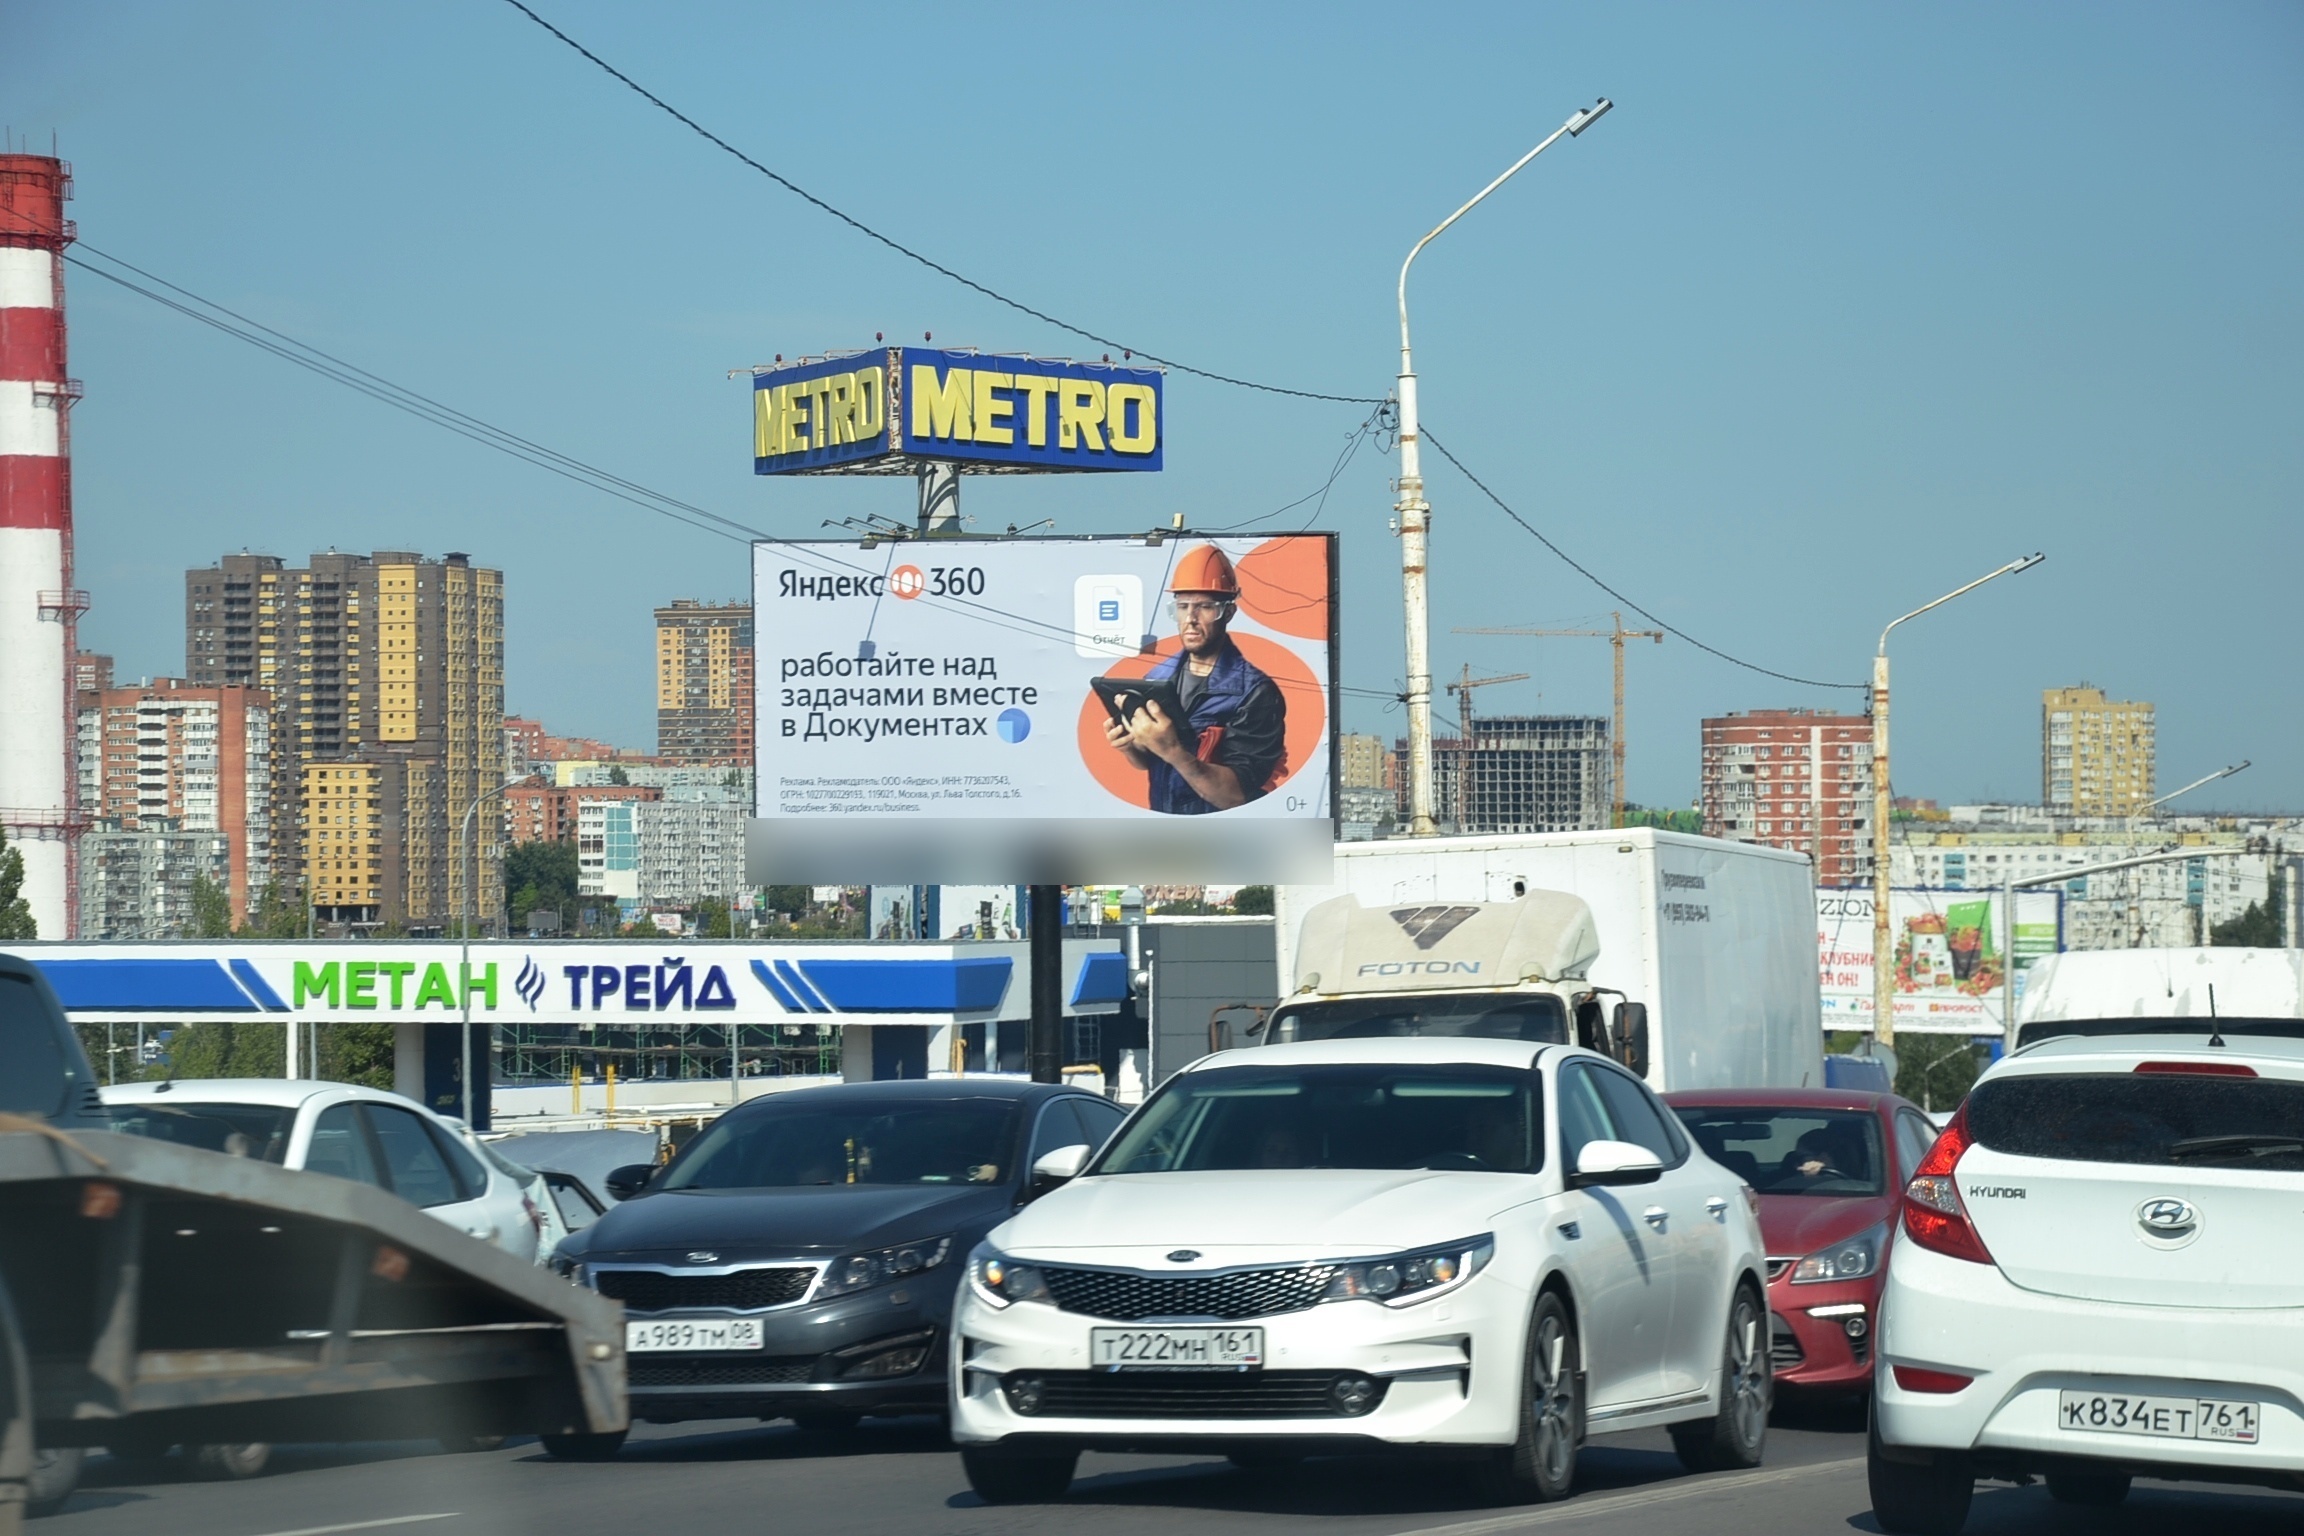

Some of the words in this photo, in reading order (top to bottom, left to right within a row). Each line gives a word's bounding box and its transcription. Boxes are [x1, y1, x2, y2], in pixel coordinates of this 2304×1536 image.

[755, 366, 883, 457] METRO
[912, 365, 1156, 453] METRO
[779, 569, 884, 601] Яндекс
[930, 567, 985, 596] 360
[1093, 634, 1125, 645] Отчёт
[781, 651, 935, 683] работайте
[943, 656, 998, 681] над
[781, 687, 924, 712] задачами
[933, 686, 1038, 706] вместе
[781, 717, 796, 737] в
[804, 711, 988, 743] Документах
[881, 776, 900, 786] ООО
[1286, 796, 1307, 811] 0+
[1357, 961, 1481, 977] FOTON
[293, 961, 498, 1010] МЕТАН
[563, 956, 737, 1011] ТРЕЙД
[1970, 1185, 2026, 1200] HYUNDAI
[635, 1324, 726, 1348] А989ТМ
[731, 1322, 755, 1340] 08
[1102, 1333, 1208, 1361] Т222МН
[1213, 1331, 1255, 1353] 161
[2069, 1397, 2193, 1433] К834ЕТ
[2200, 1403, 2250, 1430] 761
[2211, 1427, 2235, 1437] RUS
